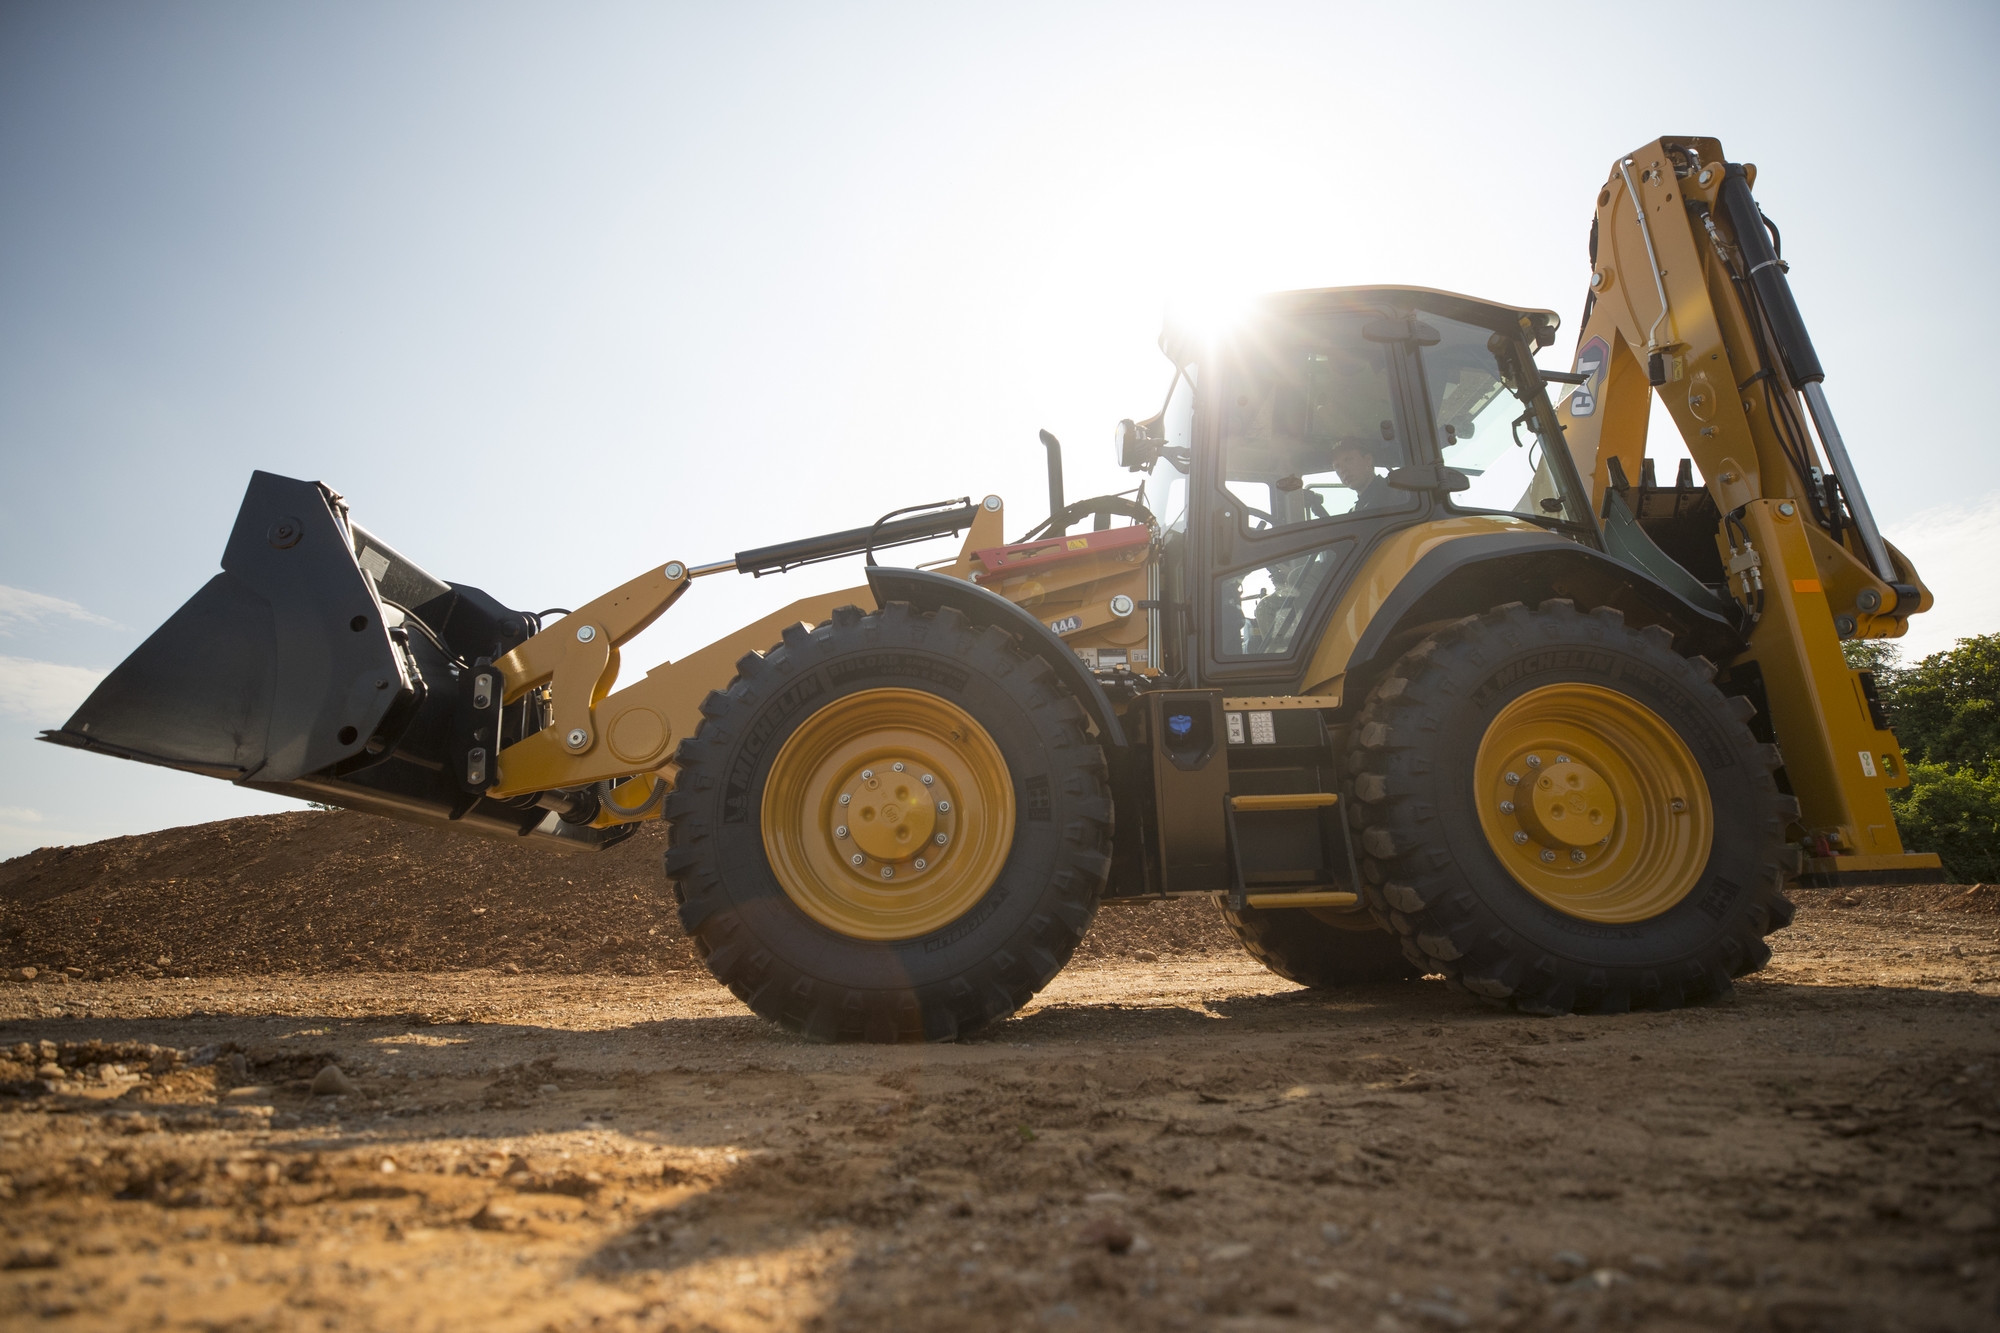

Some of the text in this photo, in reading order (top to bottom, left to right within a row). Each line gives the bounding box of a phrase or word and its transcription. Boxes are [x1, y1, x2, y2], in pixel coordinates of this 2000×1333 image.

[1051, 616, 1077, 635] 444
[828, 654, 900, 676] BIBLOAD
[1495, 651, 1615, 690] MICHELIN
[1625, 662, 1686, 705] BIBLOAD
[730, 672, 818, 790] MICHELIN
[926, 903, 995, 953] MICHELIN
[1544, 915, 1620, 939] MICHELIN
